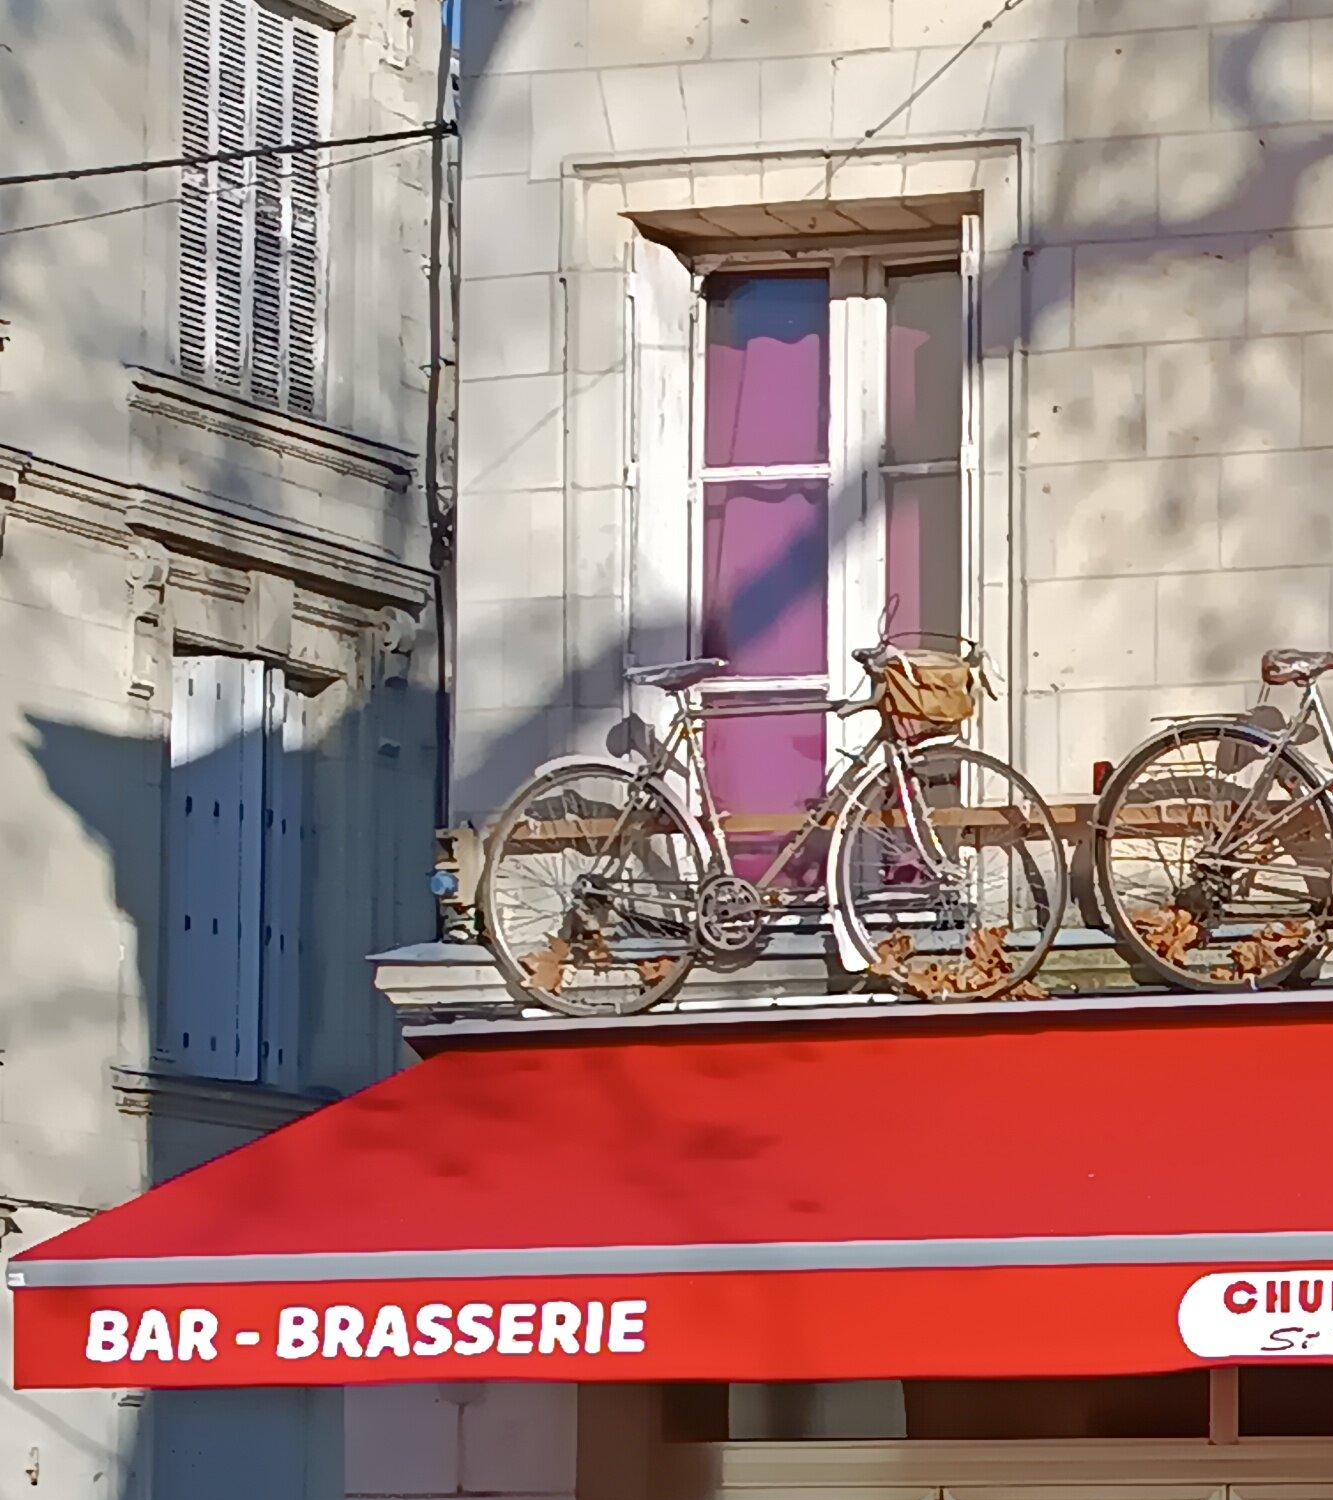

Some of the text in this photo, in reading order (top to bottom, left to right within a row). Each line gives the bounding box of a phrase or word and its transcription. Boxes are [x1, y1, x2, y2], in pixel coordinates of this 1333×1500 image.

[85, 1309, 218, 1362] BAR
[276, 1300, 647, 1359] BRASSERIE
[1261, 1326, 1320, 1352] St
